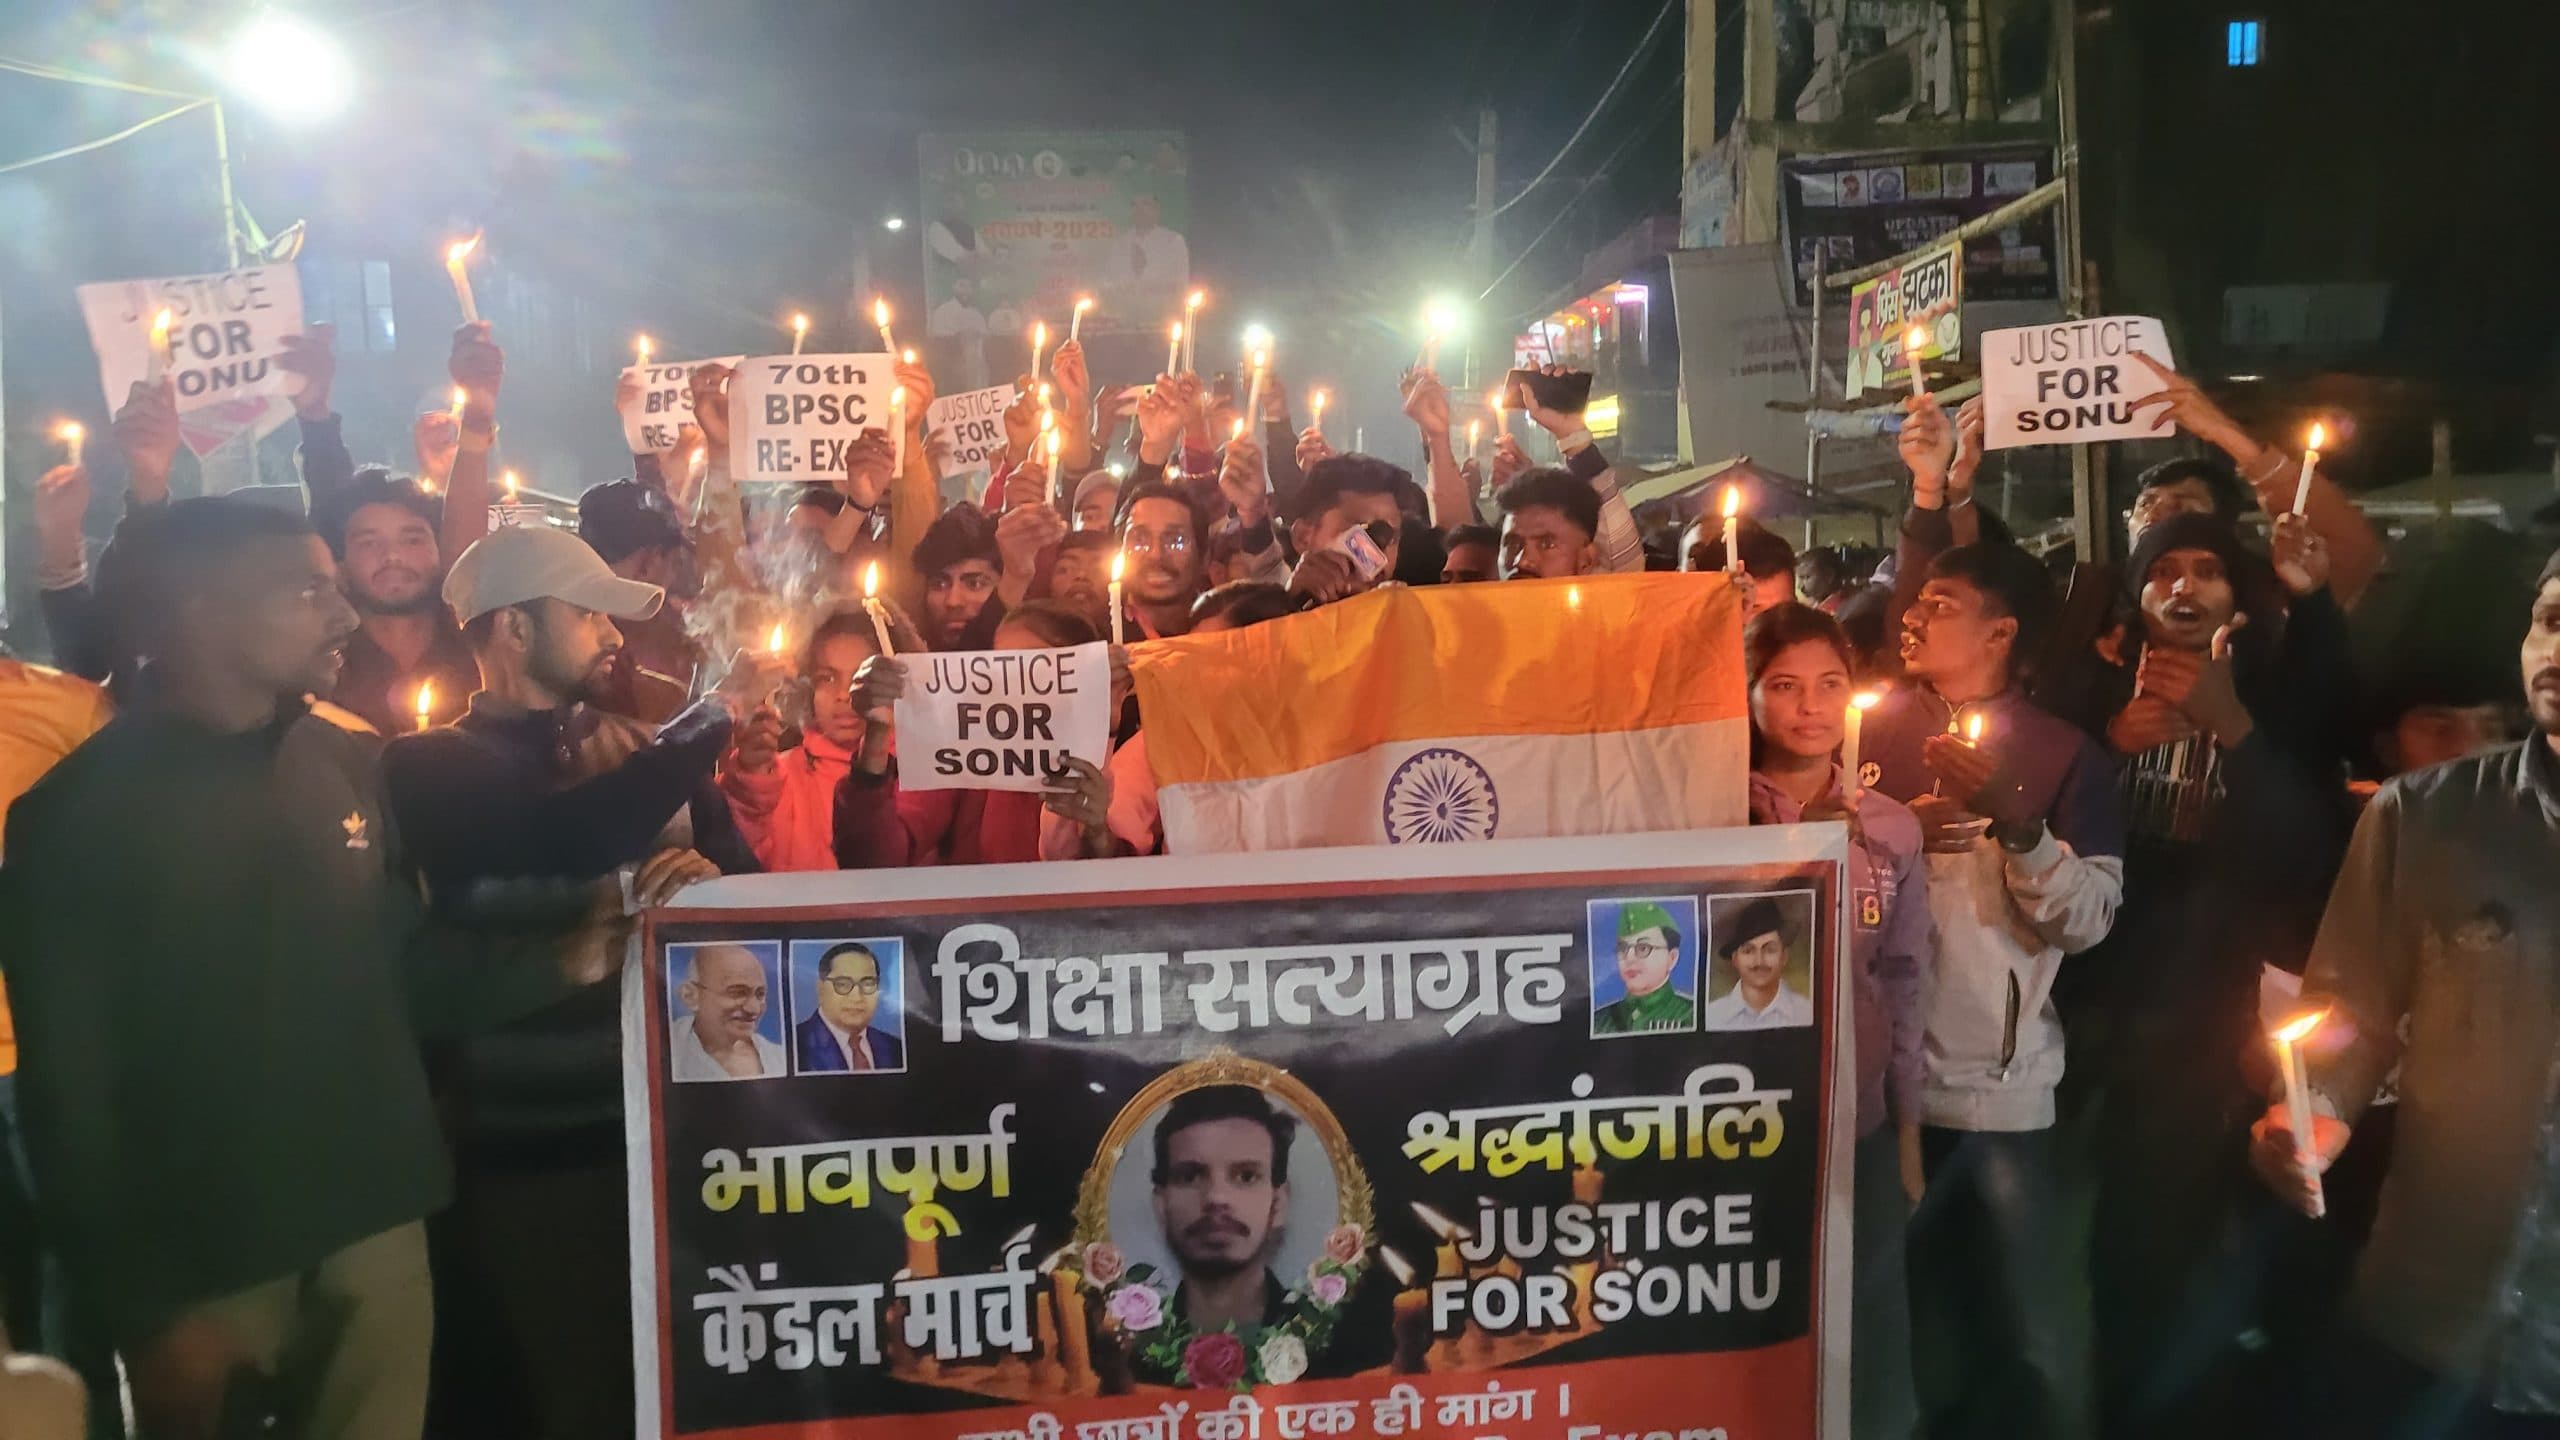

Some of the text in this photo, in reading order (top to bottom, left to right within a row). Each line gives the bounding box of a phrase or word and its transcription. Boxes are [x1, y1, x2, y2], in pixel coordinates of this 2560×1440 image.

[165, 319, 254, 368] FOR
[2010, 320, 2143, 366] JUSTICE
[176, 357, 268, 397] ONU
[768, 364, 867, 385] 70th
[2037, 364, 2119, 403] FOR
[645, 389, 695, 414] BPS
[765, 393, 868, 425] BPSC
[942, 390, 1002, 423] JUSTICE
[2017, 401, 2133, 432] SONU
[955, 420, 999, 444] FOR
[926, 652, 1078, 695] JUSTICE
[957, 702, 1054, 741] FOR
[934, 748, 1071, 777] SONU
[932, 923, 1574, 1043] शिक्षा सत्याग्रह
[1400, 1062, 1792, 1179] श्रद्धांजलि
[701, 1102, 1017, 1243] भावपूर्ण
[1460, 1194, 1753, 1262] JUSTICE
[692, 1242, 1037, 1375] कैंडल मार्च
[1431, 1258, 1781, 1333] FOR SONU
[1195, 1394, 1264, 1440] की
[1277, 1398, 1360, 1439] एक
[1370, 1384, 1425, 1434] ही
[1436, 1380, 1537, 1427] मांग
